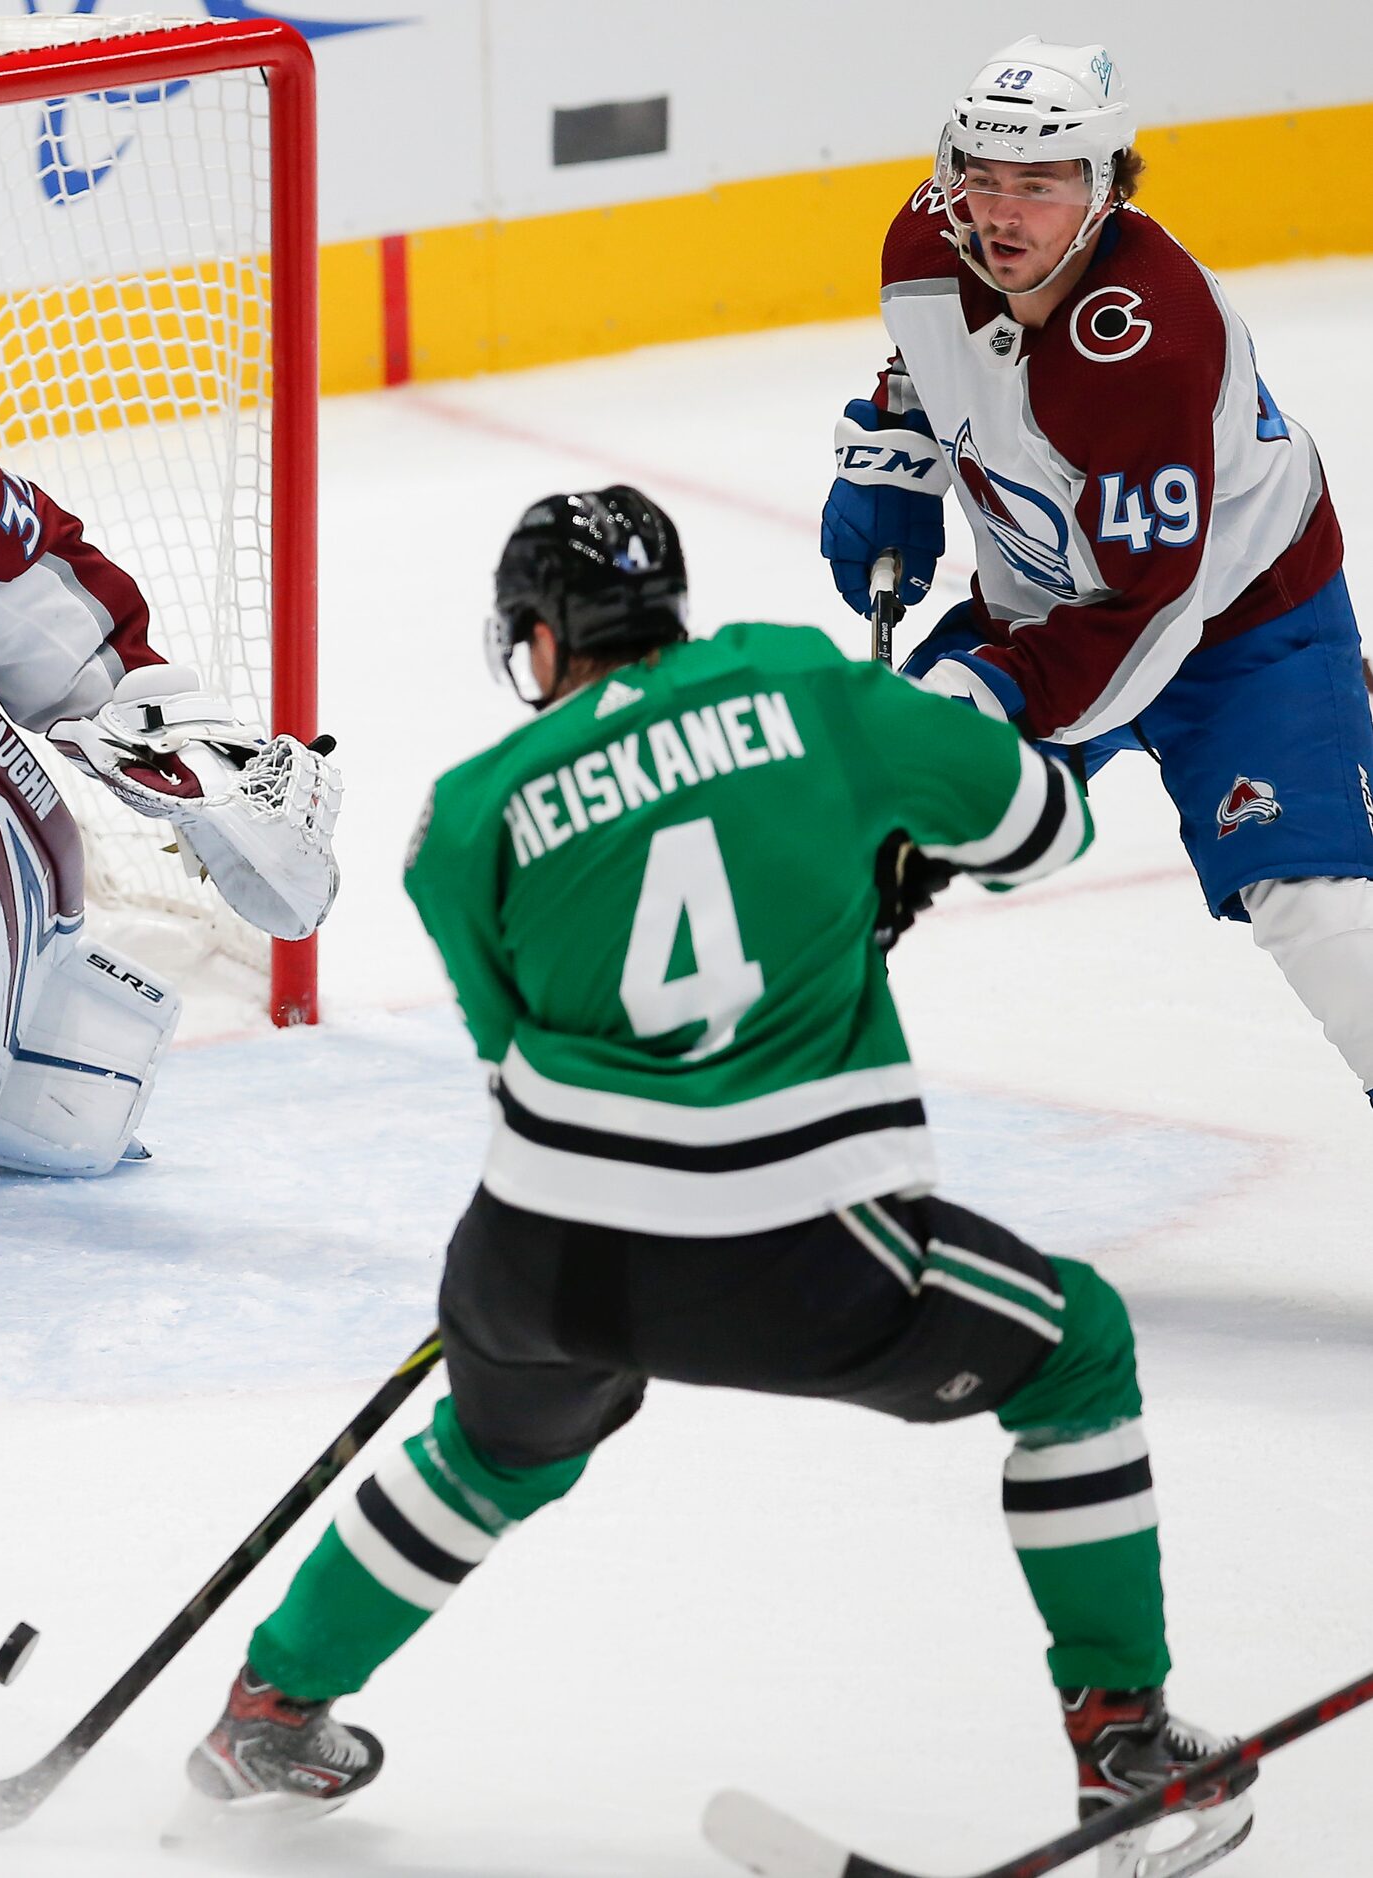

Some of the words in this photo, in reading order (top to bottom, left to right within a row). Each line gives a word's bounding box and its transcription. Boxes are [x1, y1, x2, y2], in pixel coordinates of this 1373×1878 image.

[994, 68, 1033, 90] 49
[975, 120, 1028, 135] CCM
[1097, 464, 1200, 554] 49
[502, 691, 805, 869] HEISKANEN
[619, 815, 766, 1063] 4
[86, 953, 165, 1003] SLR3
